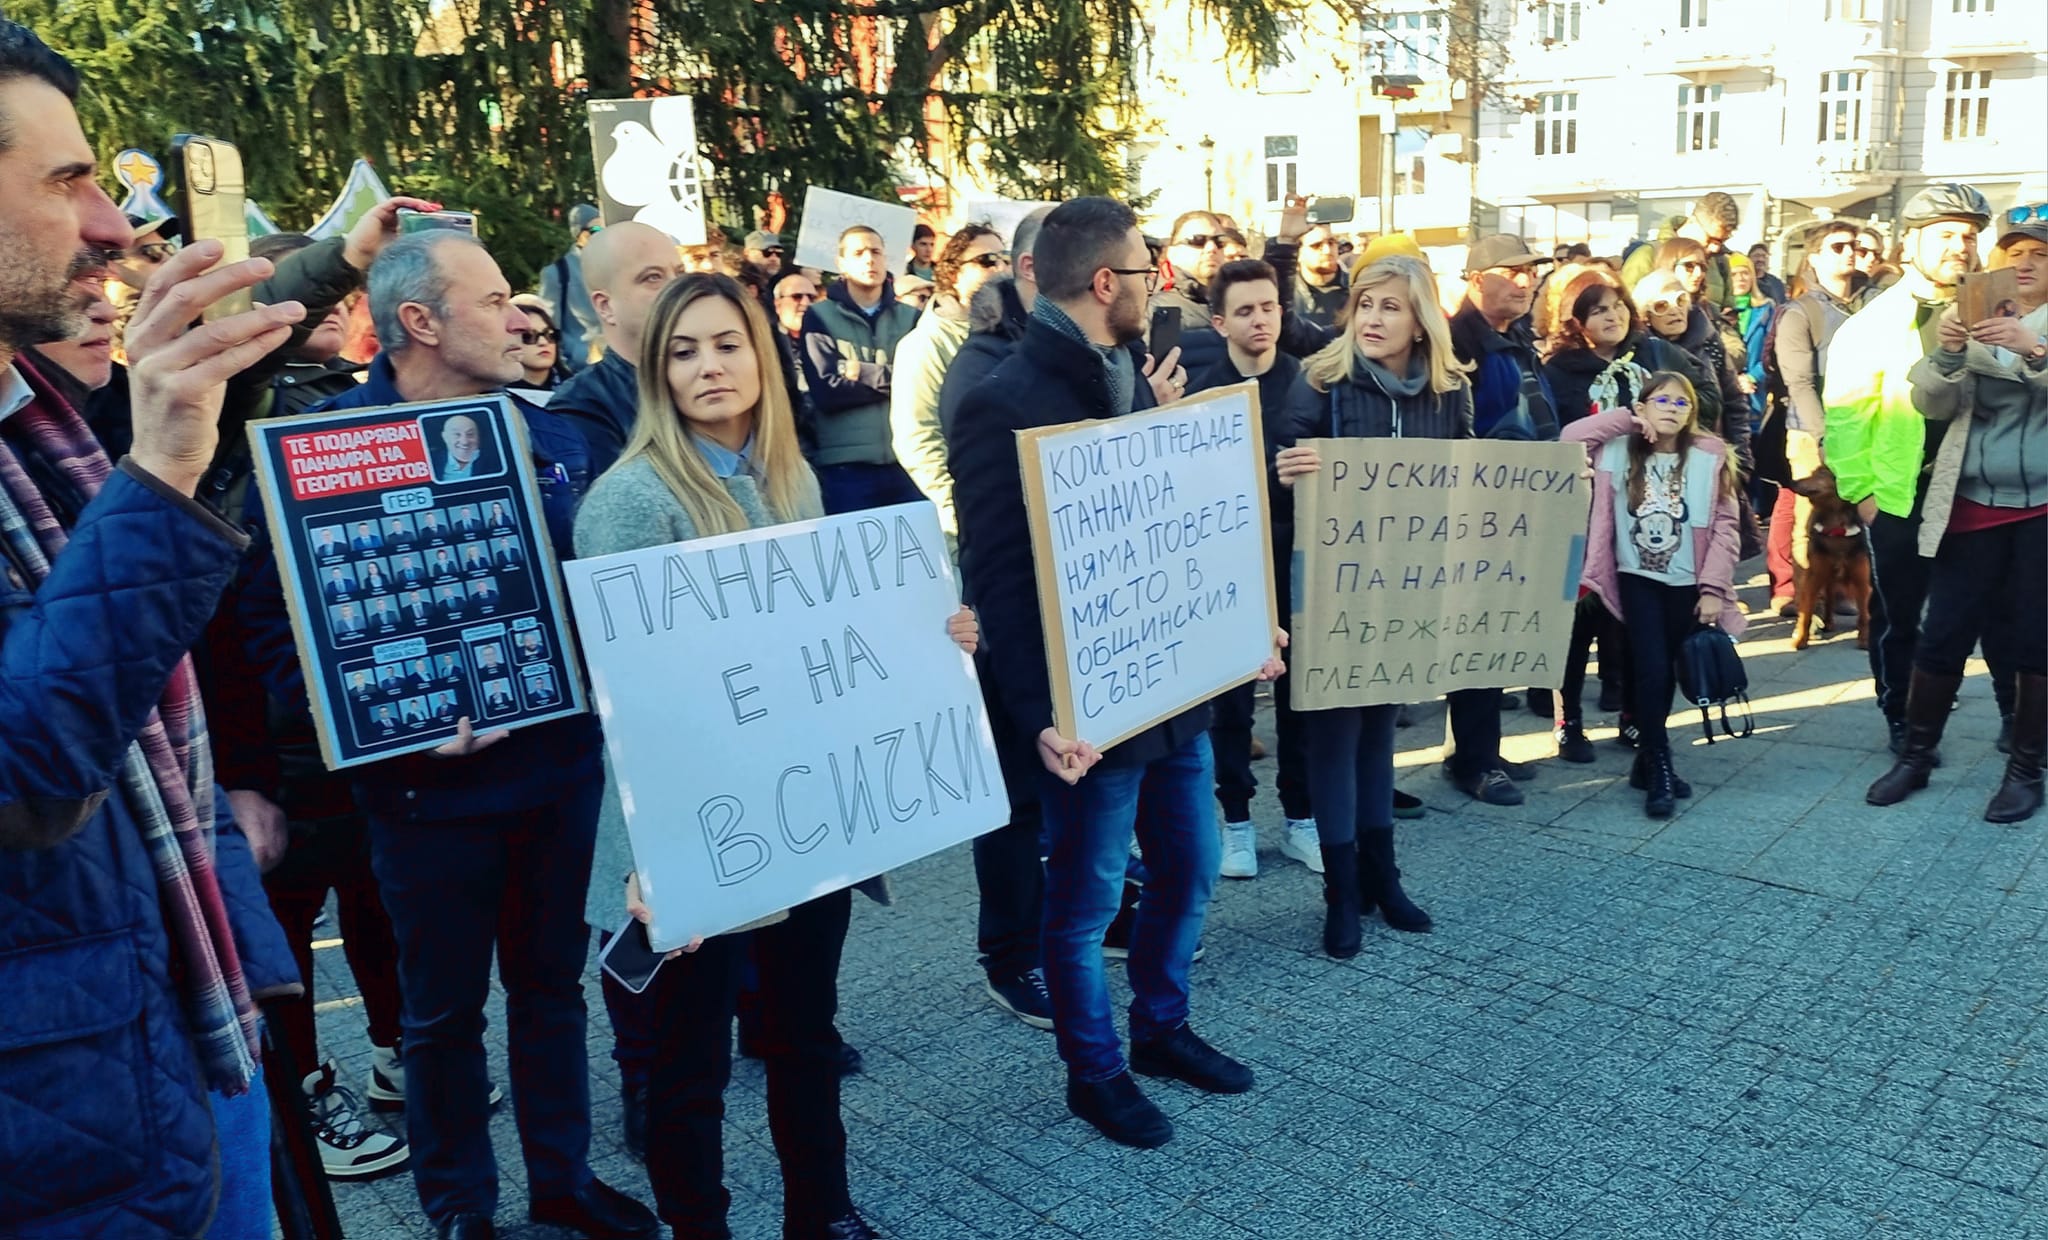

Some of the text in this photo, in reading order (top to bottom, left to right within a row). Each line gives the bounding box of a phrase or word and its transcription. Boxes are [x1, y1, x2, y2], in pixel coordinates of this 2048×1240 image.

[286, 424, 418, 455] ТЕ ПОДАРЯВАТ
[291, 446, 406, 475] ПАНАИРА НА
[296, 462, 429, 495] ГЕОРГИ ГЕРГОВ
[1049, 414, 1243, 494] КОЙТО ПРЕДАДЕ
[1332, 460, 1576, 495] РУСКИЯ КОНСУЛ
[388, 491, 427, 509] ГЕРБ
[1053, 470, 1176, 551] ПАНАИРА
[1321, 511, 1529, 546] ЗАГРАБВА
[591, 515, 937, 641] ПАНАИРА
[1065, 494, 1249, 595] НЯМА ПОВЕЧЕ
[1335, 559, 1527, 593] ПАНАИРА,
[1071, 557, 1204, 640] МЯСТО В
[1076, 582, 1239, 677] ОБЩИНСКИЯ
[721, 624, 888, 725] Е НА
[1082, 640, 1184, 719] СЪВЕТ
[1305, 662, 1415, 694] ГЛЕДА
[1450, 651, 1550, 676] СЕИРА
[697, 704, 991, 887] ВСИЧКИ
